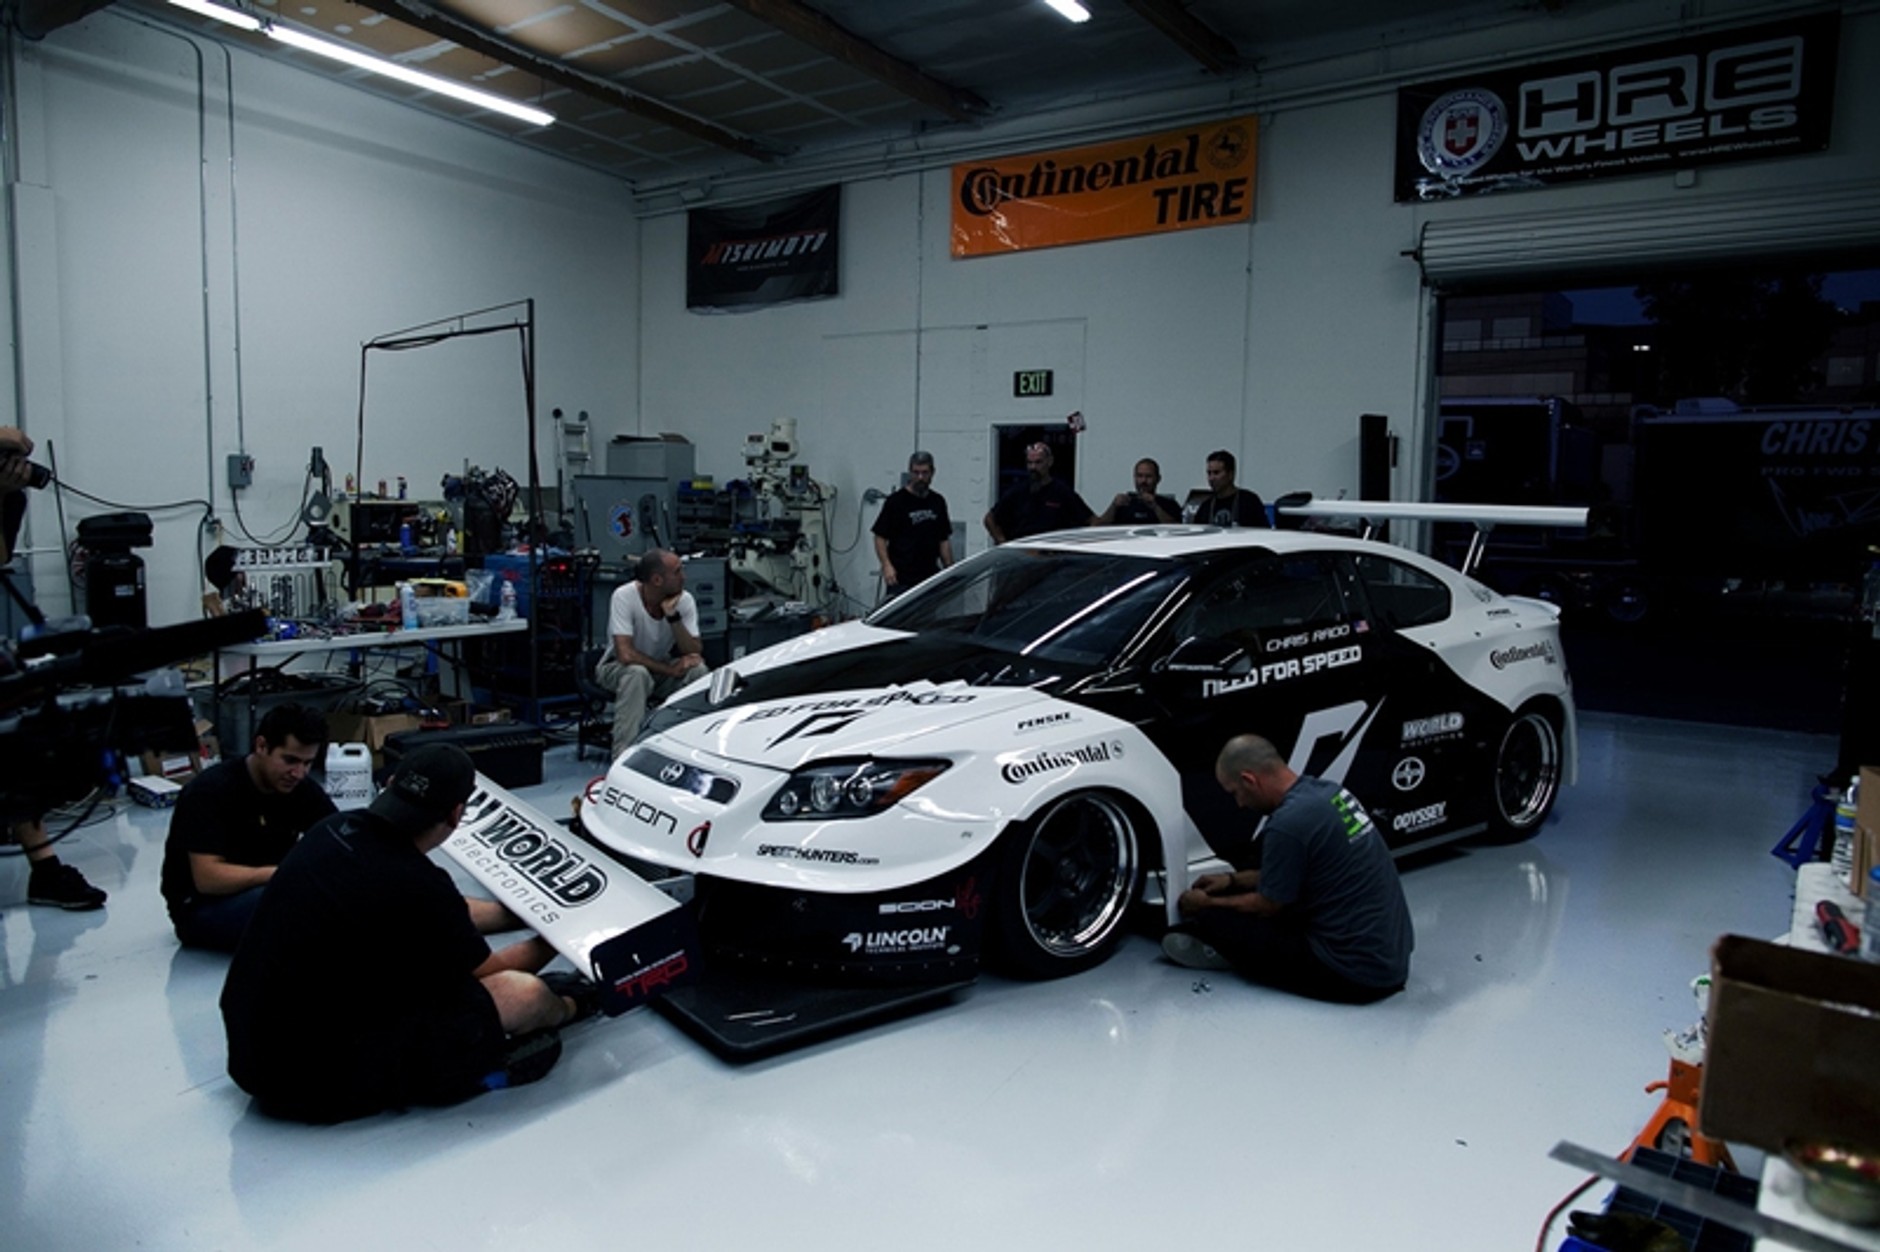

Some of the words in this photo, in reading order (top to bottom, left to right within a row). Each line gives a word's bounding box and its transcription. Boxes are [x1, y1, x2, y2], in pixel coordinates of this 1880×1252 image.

[1518, 36, 1804, 138] HRE
[1516, 105, 1798, 162] WHEELS
[960, 134, 1200, 216] Continental
[1153, 177, 1248, 225] TIRE
[1019, 371, 1048, 394] EXIT
[1760, 420, 1873, 455] CHRIS
[1265, 631, 1310, 652] CHRIS
[1311, 623, 1350, 643] RADO
[1260, 657, 1301, 685] FOR
[1302, 644, 1363, 675] SPEED
[1018, 712, 1071, 729] PENSKE
[1401, 711, 1465, 741] WORLD
[1001, 741, 1111, 784] Continental
[602, 786, 678, 835] SCION
[1392, 800, 1447, 831] ODYSSEY
[472, 808, 607, 908] WORLD
[453, 837, 560, 925] electronics
[878, 898, 956, 915] SCION
[866, 925, 947, 951] LINCOLN
[613, 955, 690, 998] TRD
